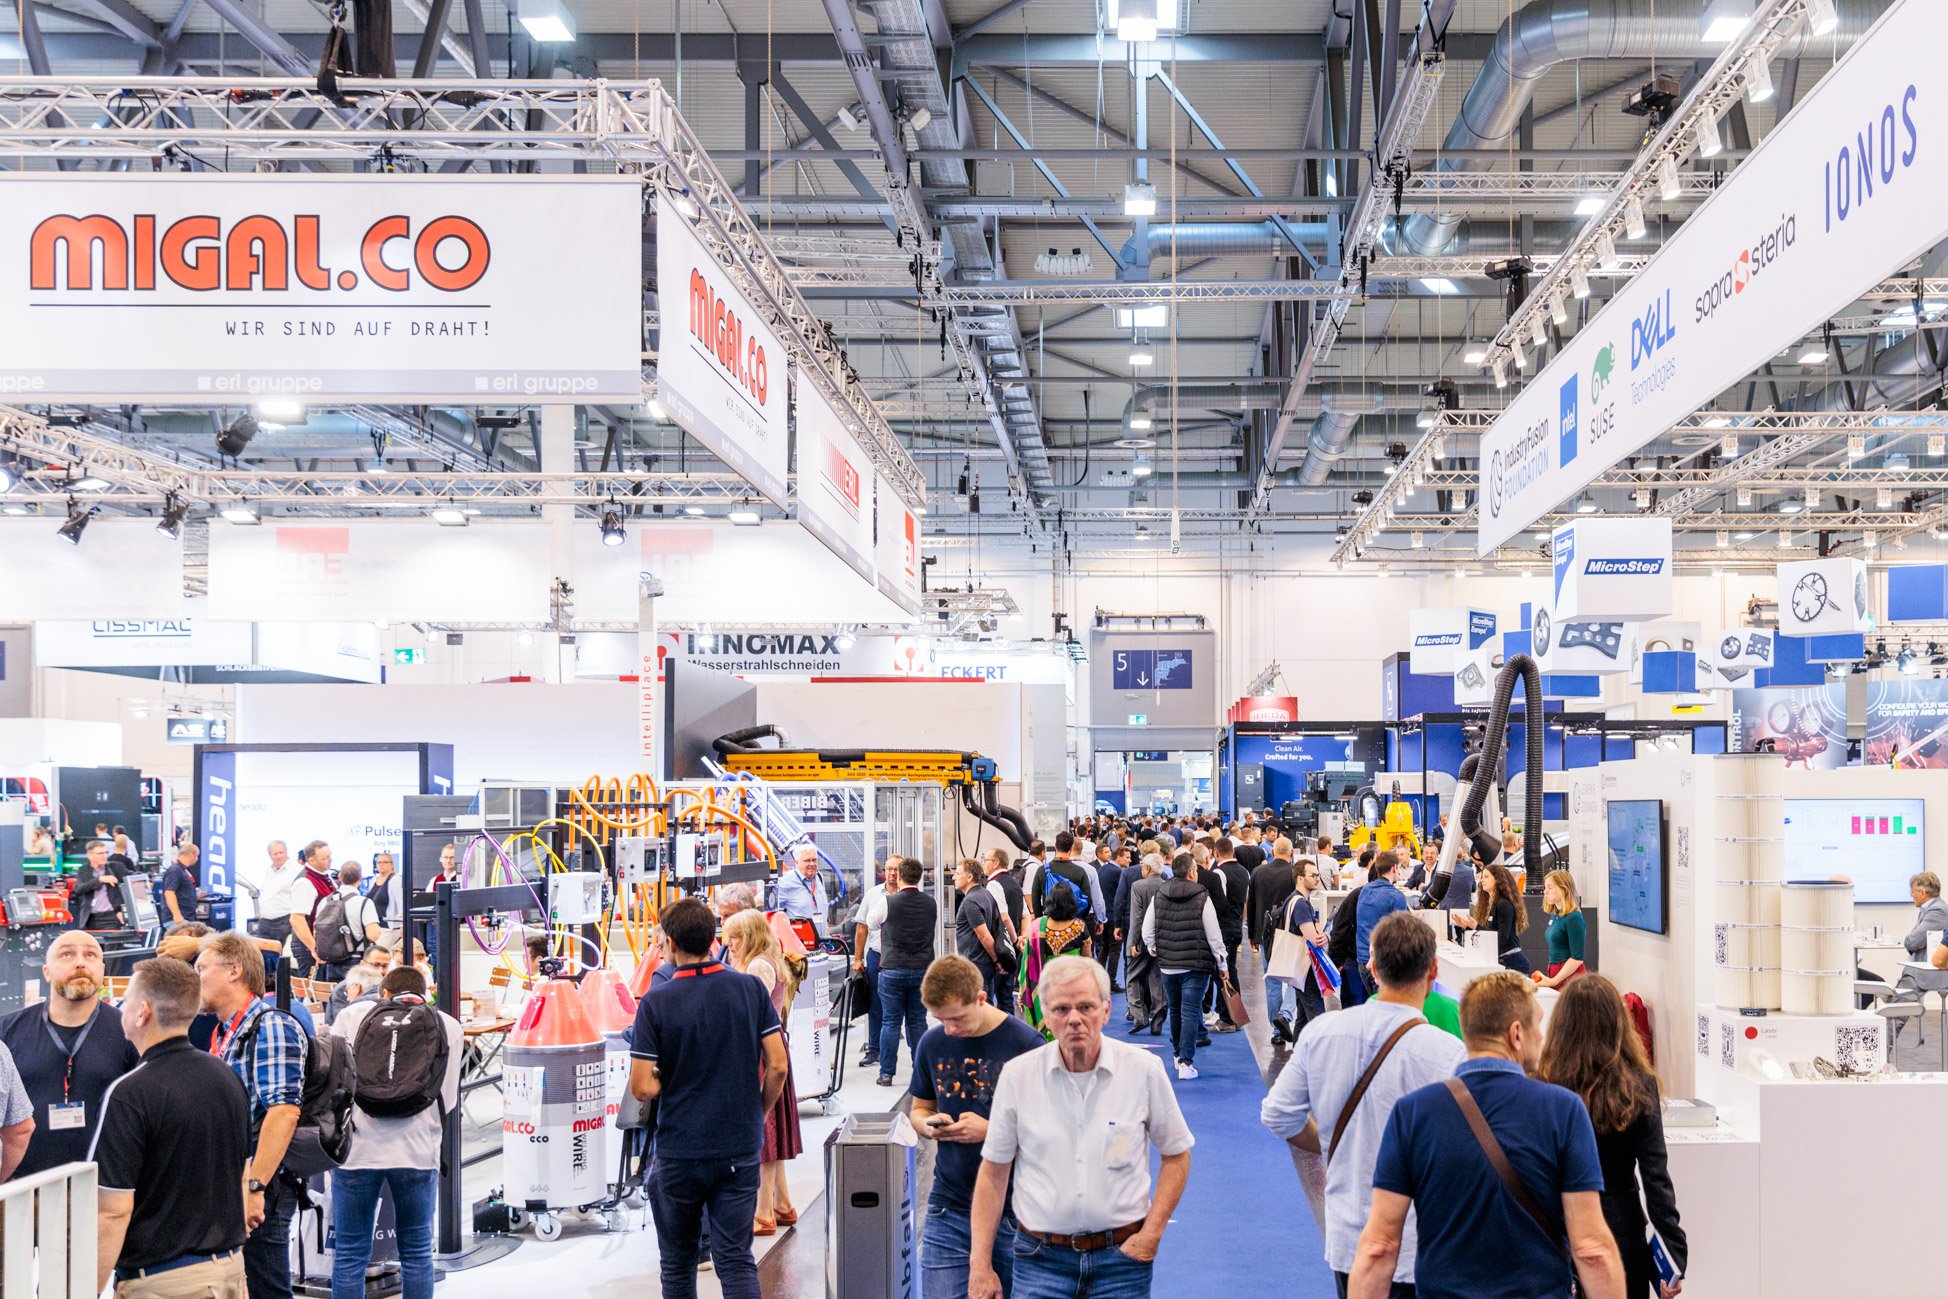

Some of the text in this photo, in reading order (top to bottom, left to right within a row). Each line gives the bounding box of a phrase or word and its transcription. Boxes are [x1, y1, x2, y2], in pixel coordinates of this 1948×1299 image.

[1825, 84, 1917, 233] IONOS
[30, 213, 491, 292] MIGAL.CO
[1696, 213, 1796, 323] sopra steria
[226, 321, 491, 336] WIR SIND AUF DRAHT!
[690, 267, 768, 407] MIGAL.CO
[1631, 287, 1675, 371] DELL
[0, 376, 44, 393] ppe
[215, 374, 323, 394] erl gruppe
[493, 373, 599, 394] erl gruppe
[1631, 357, 1676, 406] Technologies
[1561, 402, 1576, 437] intel
[1590, 401, 1615, 444] SUSE
[1505, 418, 1549, 472] IndustryFusion
[1505, 445, 1549, 503] FOUNDATION
[1588, 560, 1660, 574] MicroStep
[687, 634, 841, 655] INNOMAX
[1417, 634, 1461, 646] MicroStep
[941, 666, 1007, 679] ECKERT
[1116, 653, 1127, 671] 5
[642, 655, 653, 757] intelliplace
[1892, 709, 1919, 717] SAFETY
[208, 776, 232, 895] head
[365, 825, 402, 837] Pulse
[530, 1135, 549, 1143] eco
[573, 1134, 583, 1169] WIRE
